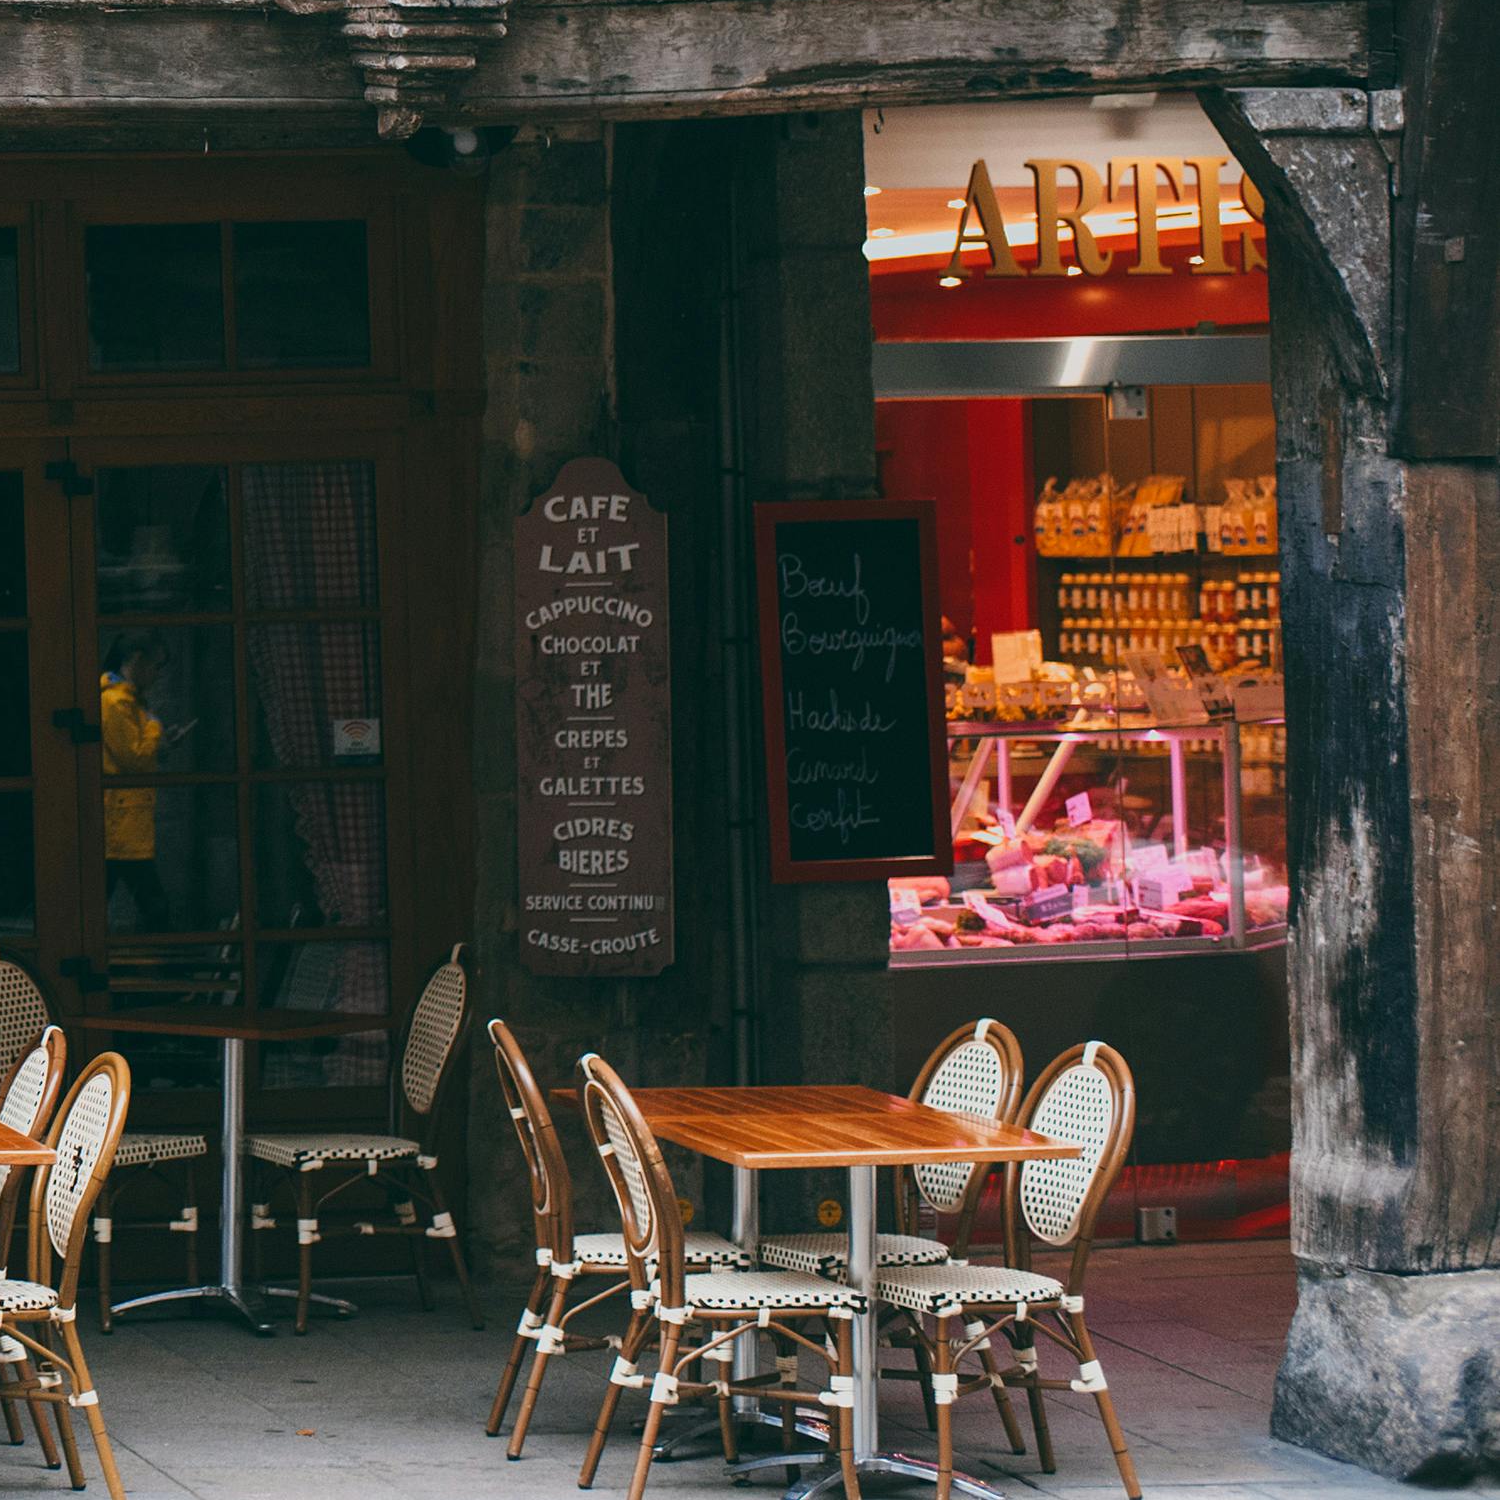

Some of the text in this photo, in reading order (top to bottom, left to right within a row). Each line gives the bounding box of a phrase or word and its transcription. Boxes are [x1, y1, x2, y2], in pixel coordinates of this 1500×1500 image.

[544, 494, 630, 522] CAFE
[577, 527, 599, 544] ET
[538, 543, 640, 574] LAIT
[525, 595, 653, 630] CAPPUCCINO
[540, 635, 640, 654] CHOCOLAT
[580, 660, 601, 676] ET
[570, 683, 613, 709] THE
[554, 729, 628, 748] CREPES
[583, 756, 601, 769] ET
[539, 776, 645, 796] GALETTES
[553, 817, 634, 841] CIDRES
[559, 850, 629, 875] BIERES
[526, 895, 583, 910] SERVICE
[527, 928, 660, 955] CASSE-CROUTE
